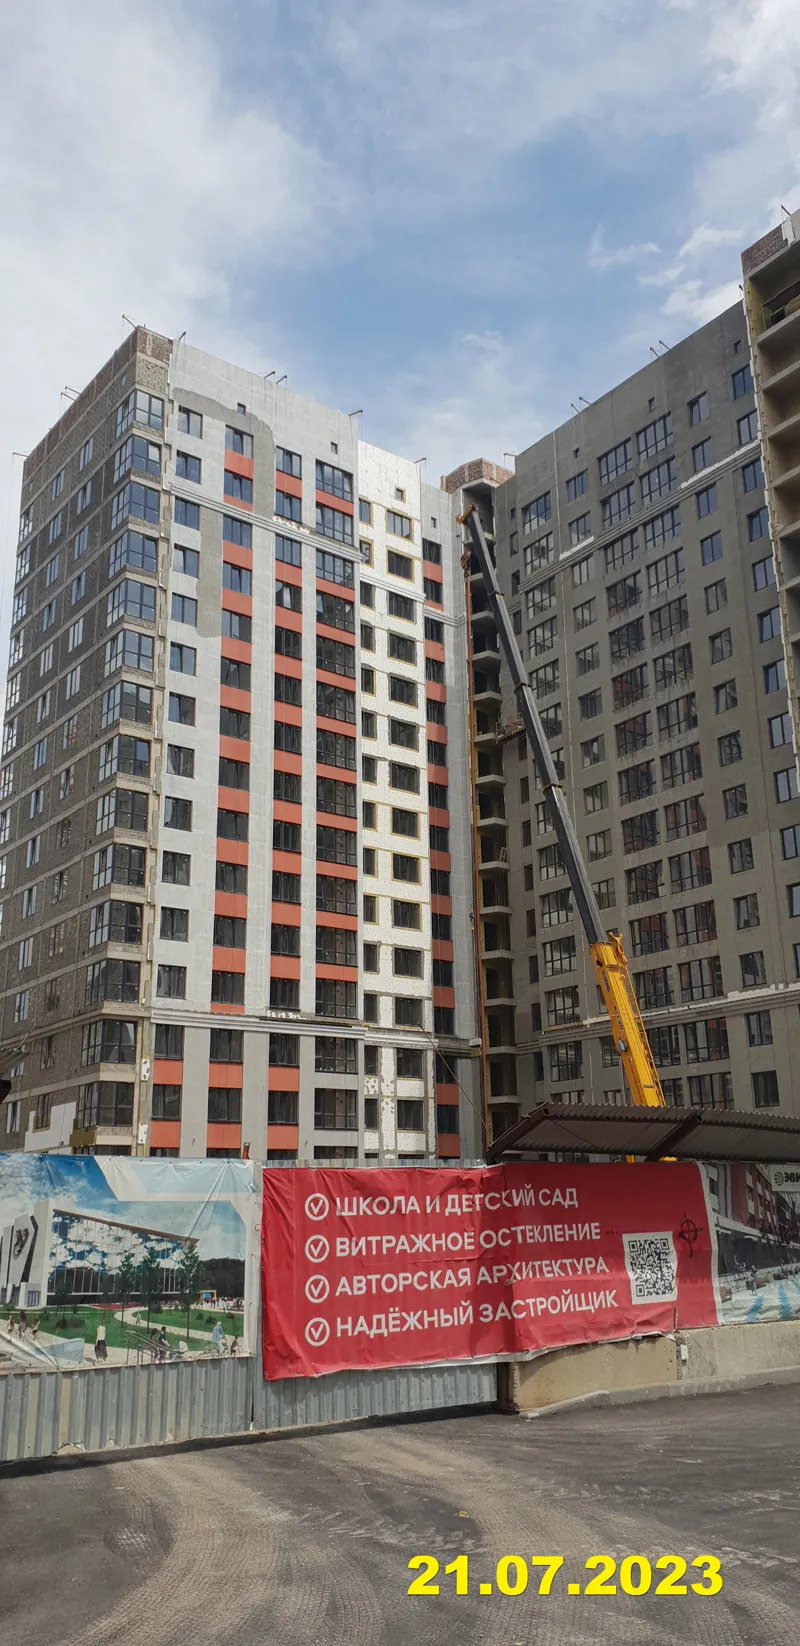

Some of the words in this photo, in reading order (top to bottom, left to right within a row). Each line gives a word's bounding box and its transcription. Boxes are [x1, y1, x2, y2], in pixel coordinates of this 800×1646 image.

[336, 1195, 421, 1216] ШКОЛА
[425, 1195, 440, 1213] И
[445, 1184, 535, 1216] ДЕТСКИЙ
[538, 1188, 579, 1209] САД
[336, 1231, 475, 1257] ВИТРАЖНОЕ
[479, 1222, 601, 1248] ОСТЕКЛЕНИЕ
[335, 1267, 472, 1296] АВТОРСКАЯ
[477, 1256, 610, 1285] АРХИТЕКТУРА
[336, 1300, 474, 1338] НАДЁЖНЫЙ
[479, 1288, 618, 1323] ЗАСТРОЙЩИК
